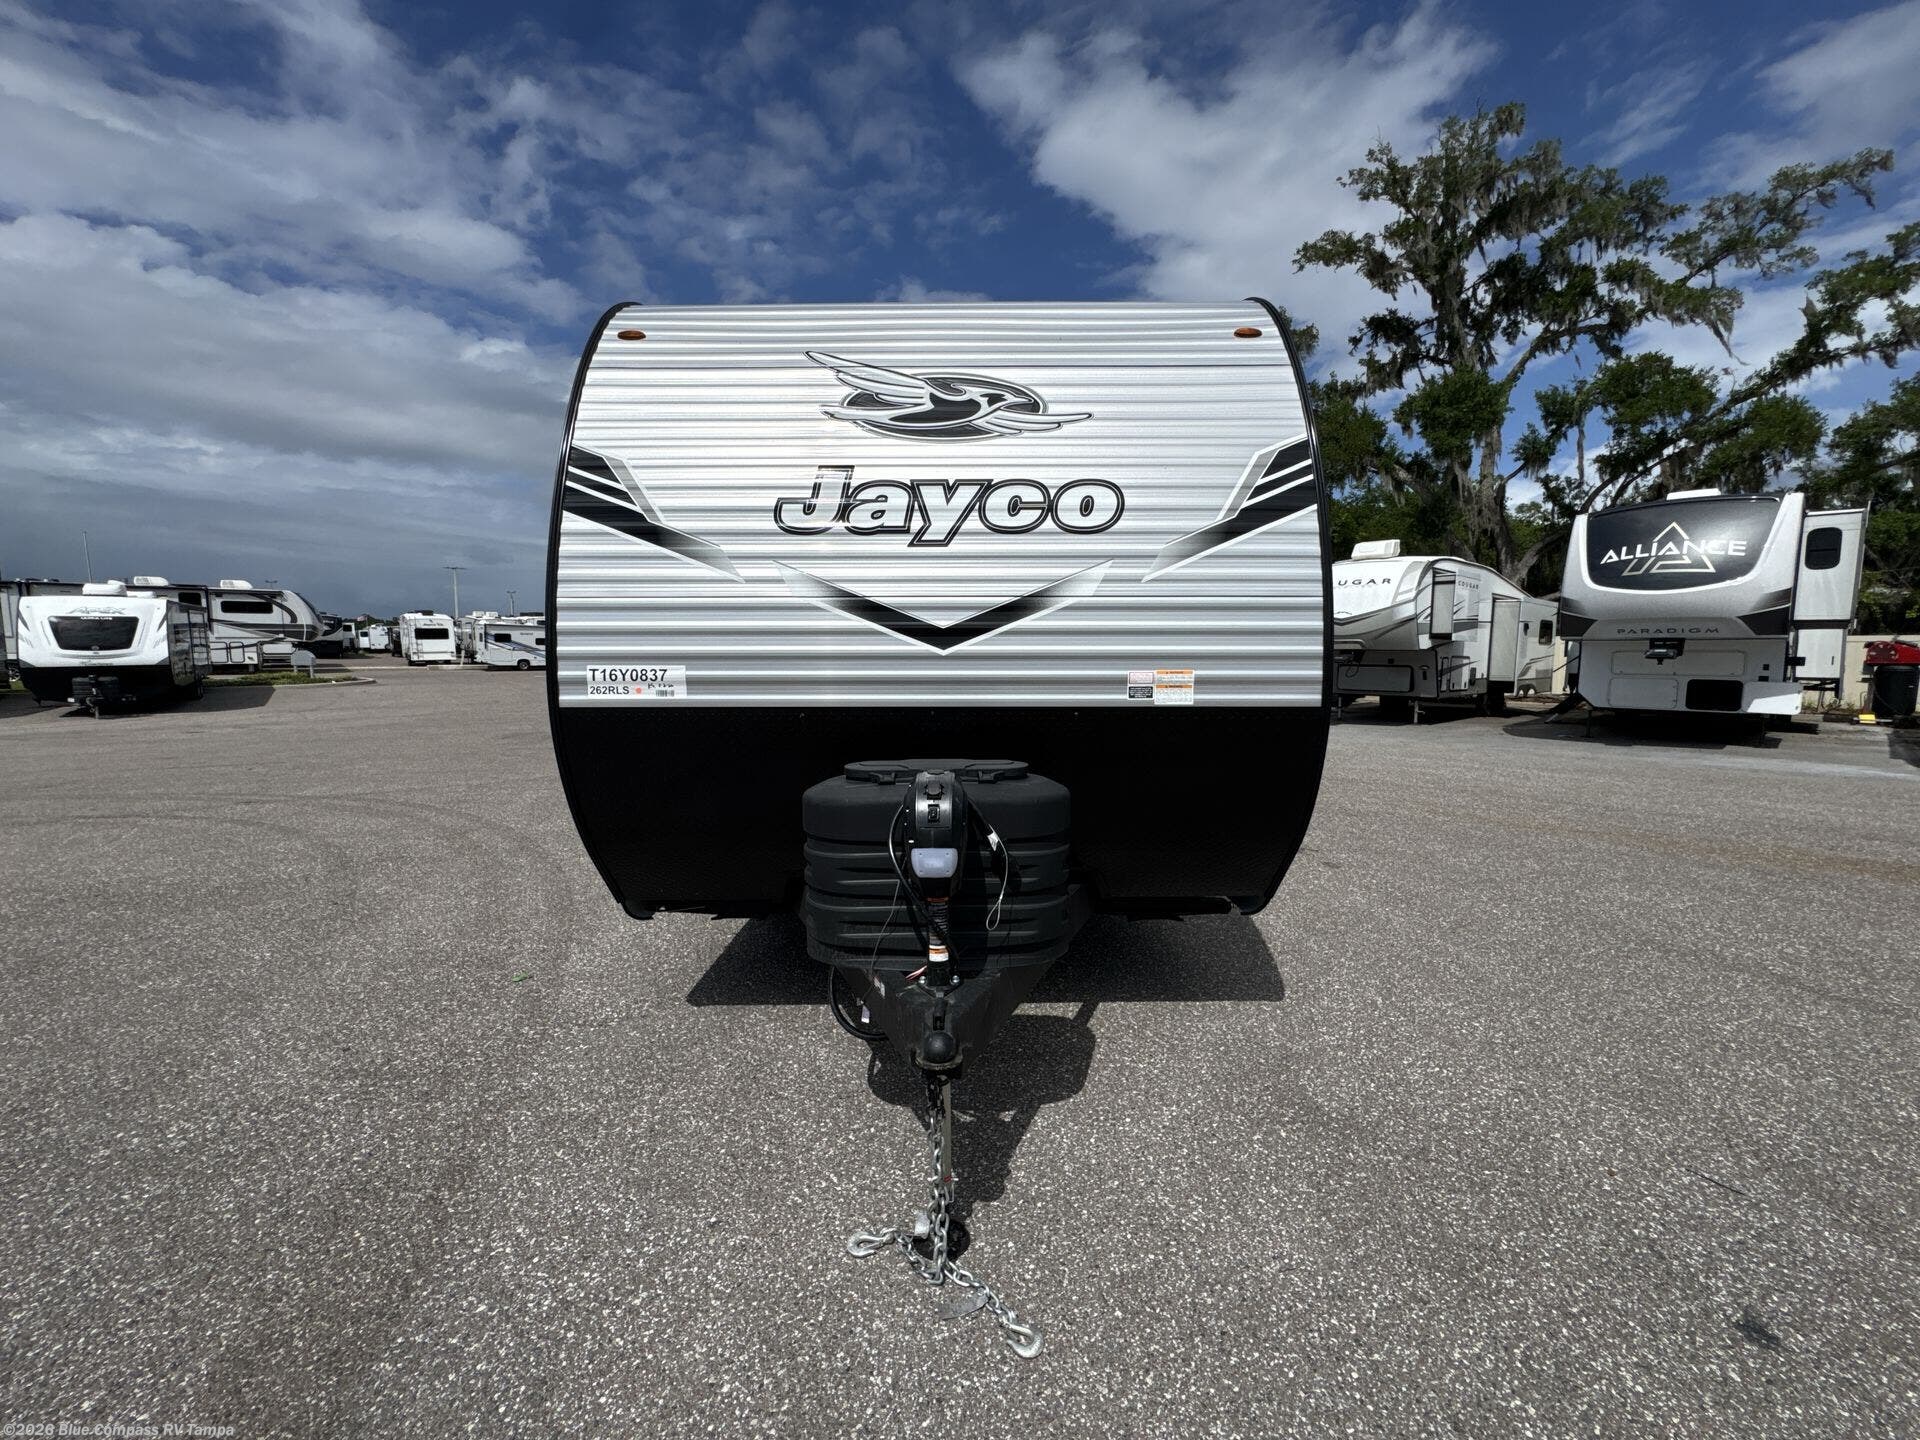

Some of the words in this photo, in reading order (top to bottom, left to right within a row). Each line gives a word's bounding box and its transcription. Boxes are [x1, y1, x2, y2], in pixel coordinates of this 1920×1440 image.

[773, 464, 1125, 548] Jayco
[1600, 539, 1747, 565] ALLIANCE
[1338, 578, 1391, 586] UGAR
[1458, 580, 1479, 590] COUGAR
[589, 668, 668, 682] T16Y0837
[589, 685, 630, 695] 262RLS
